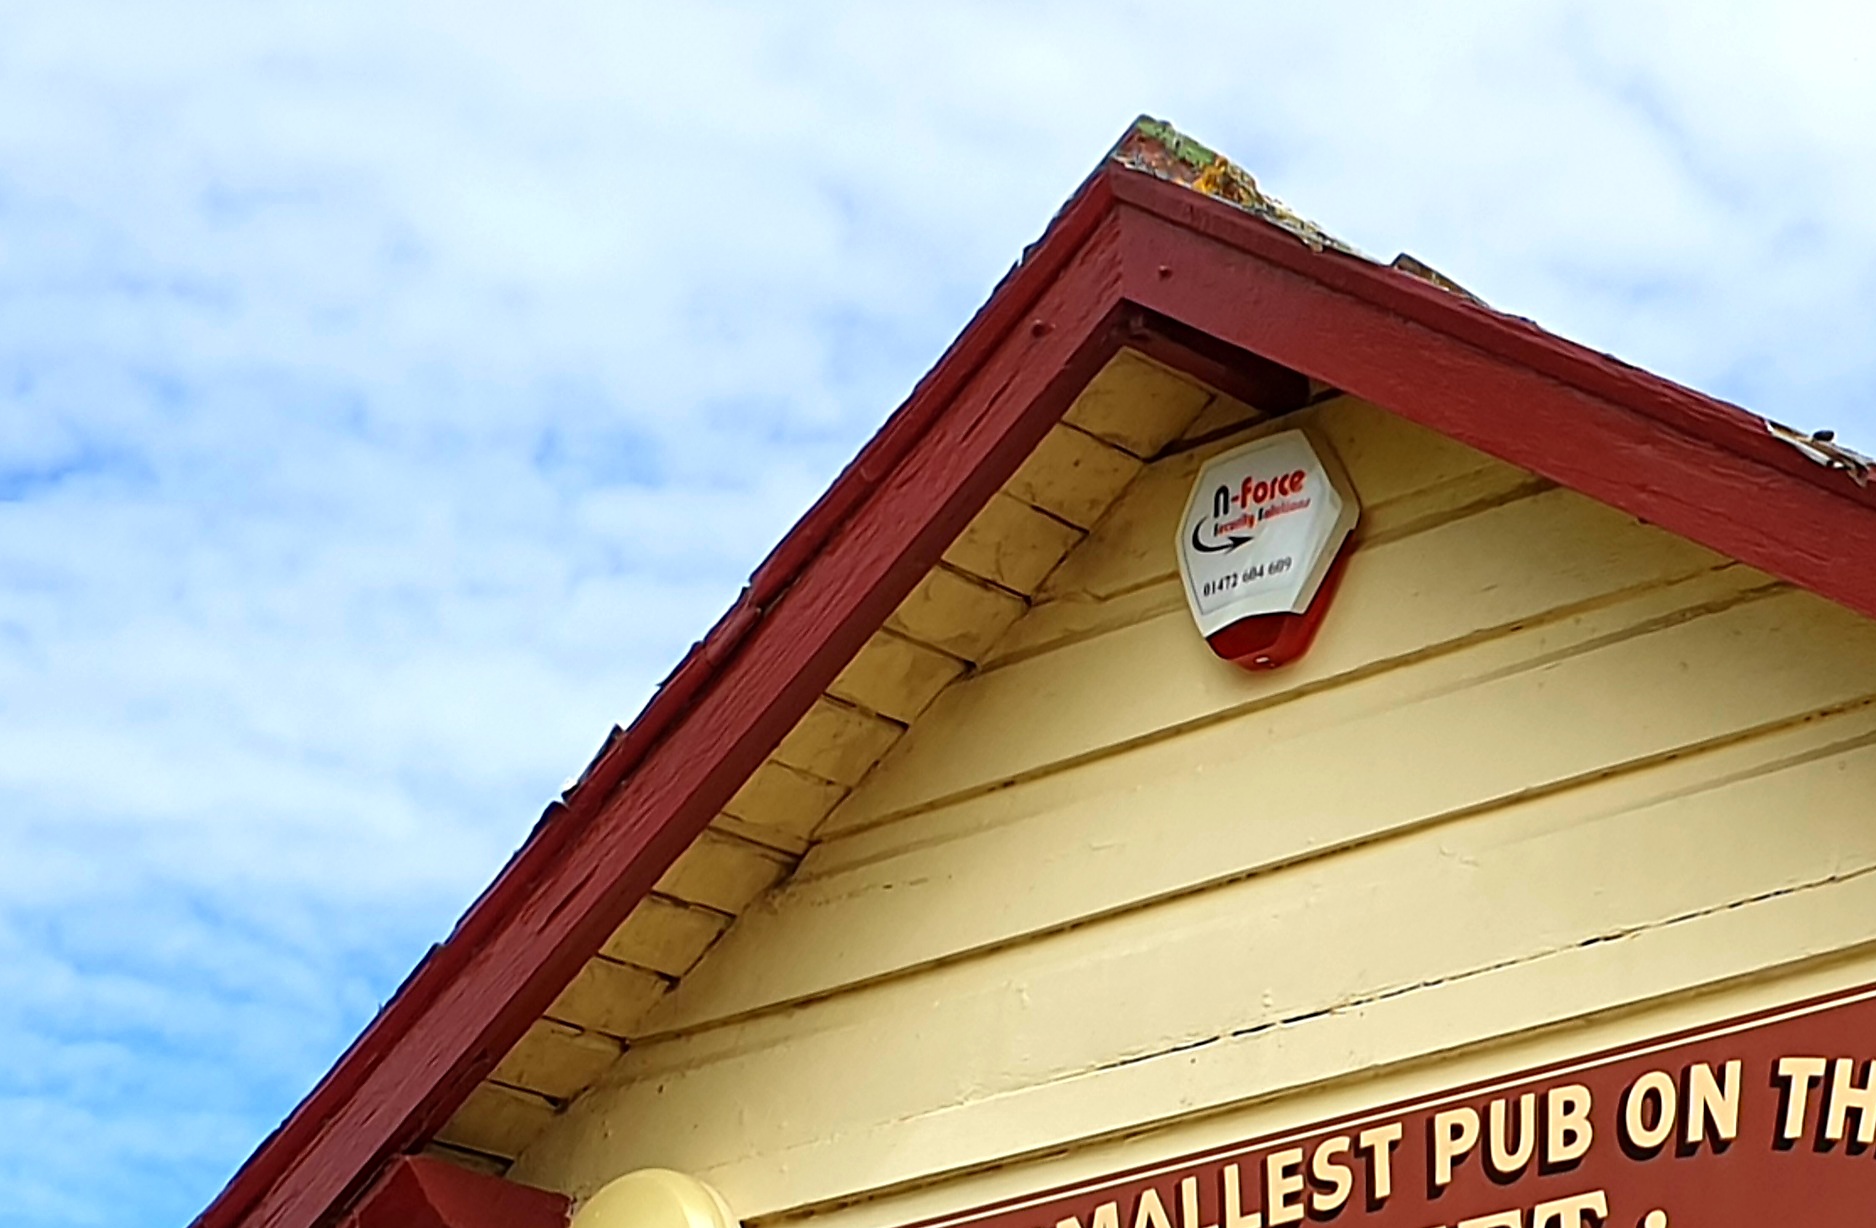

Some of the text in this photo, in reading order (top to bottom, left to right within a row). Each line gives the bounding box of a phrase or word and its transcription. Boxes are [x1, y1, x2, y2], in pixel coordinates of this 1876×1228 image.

[1204, 573, 1238, 596] 01472
[1434, 1083, 1594, 1186] PUB
[1625, 1059, 1742, 1148] ON
